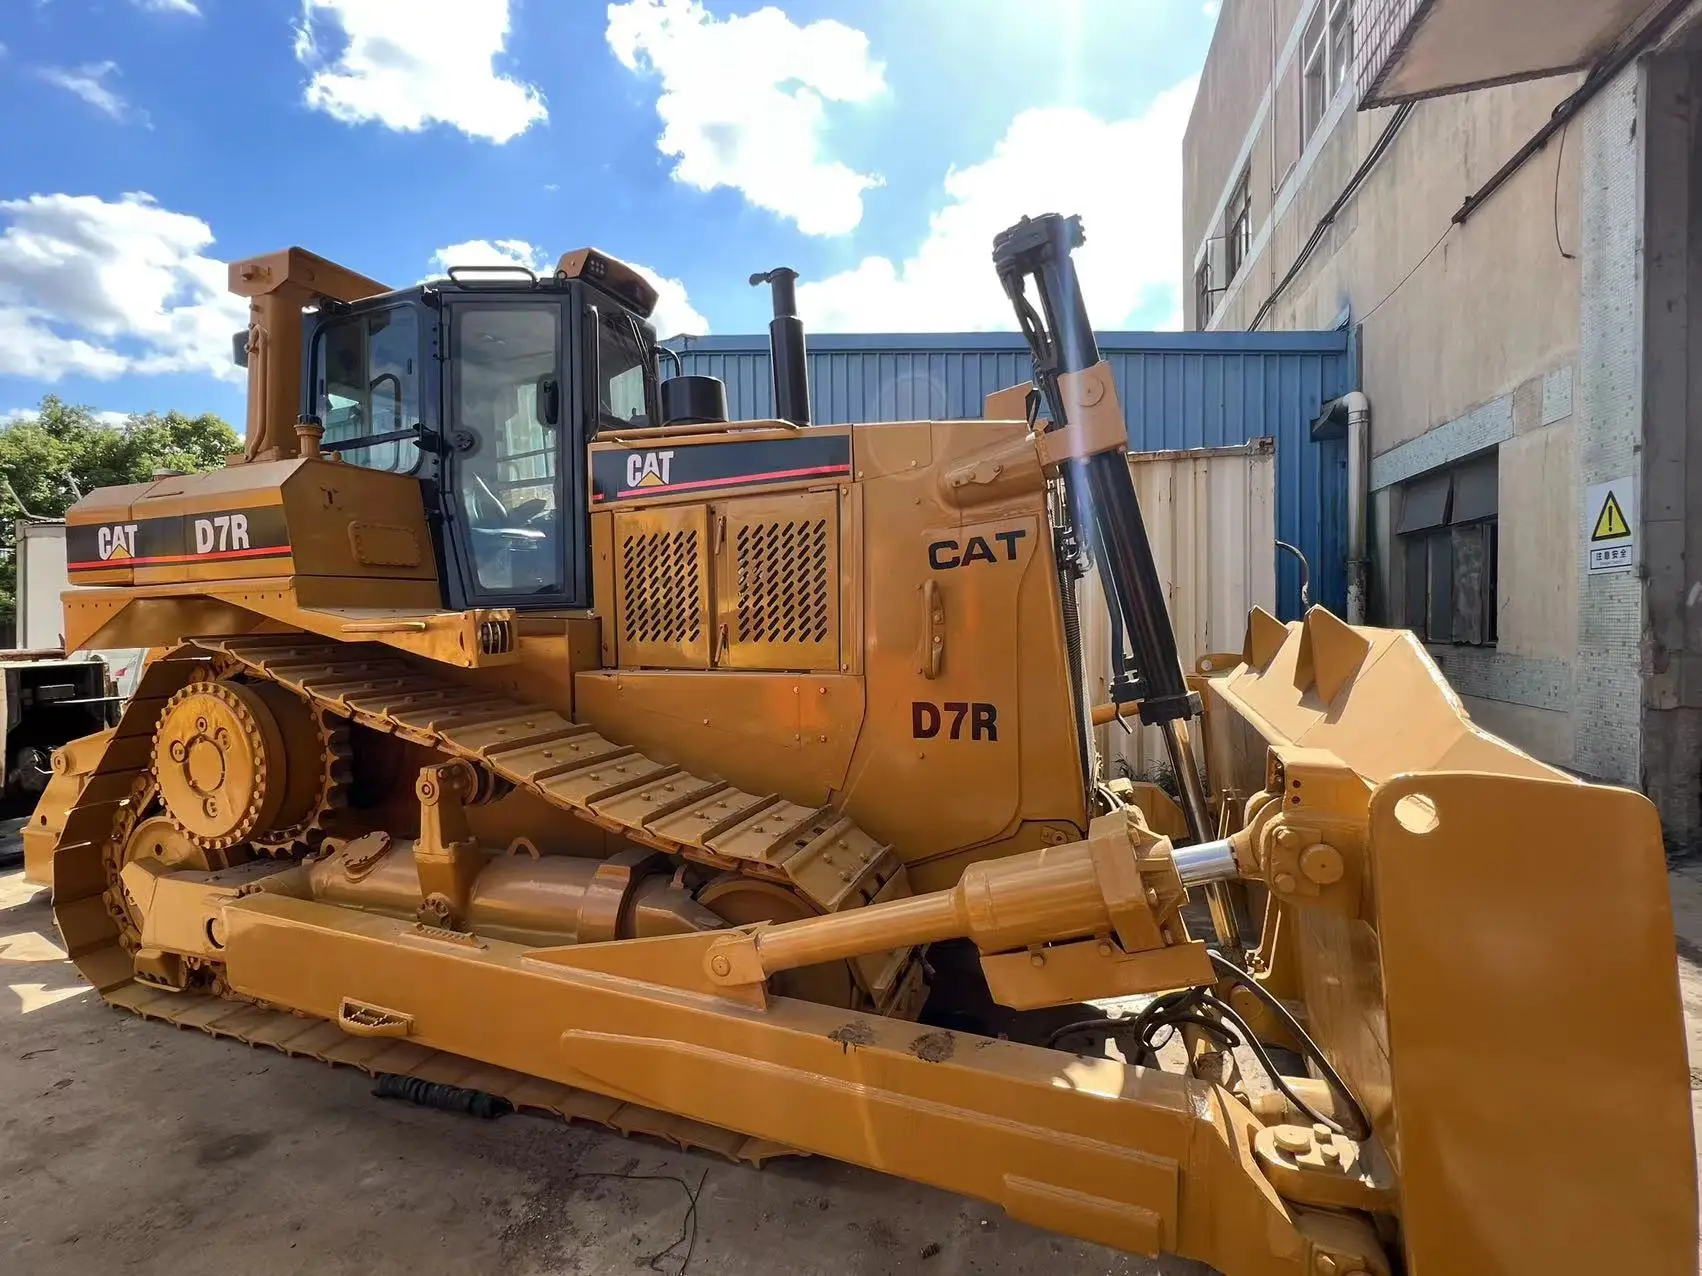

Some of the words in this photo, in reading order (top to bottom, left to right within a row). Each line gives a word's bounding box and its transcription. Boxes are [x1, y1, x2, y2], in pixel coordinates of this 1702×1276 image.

[626, 450, 674, 487] CAT
[98, 524, 138, 560] CAT
[195, 514, 250, 554] D7R
[928, 529, 1026, 570] CAT
[1596, 549, 1627, 561] 注意安全
[912, 701, 998, 741] D7R
